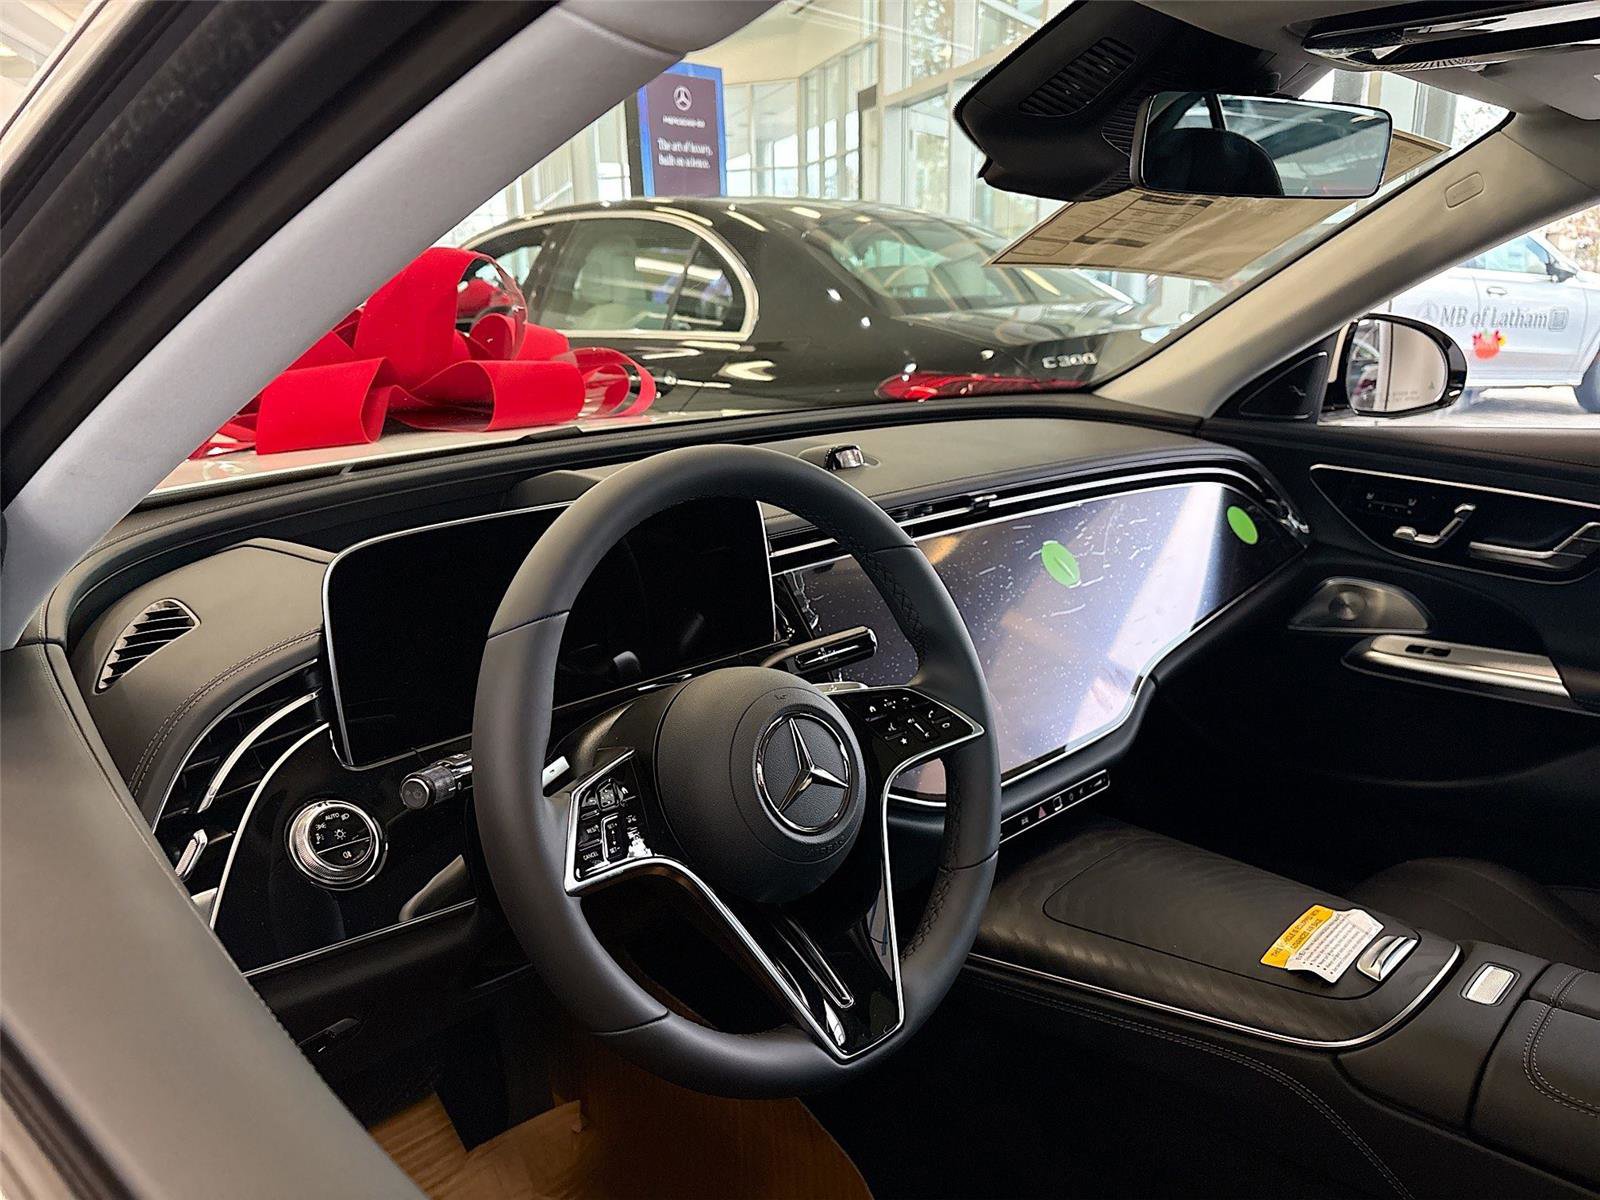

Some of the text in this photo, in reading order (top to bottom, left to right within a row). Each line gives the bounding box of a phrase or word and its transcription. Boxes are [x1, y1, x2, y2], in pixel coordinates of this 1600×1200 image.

[1440, 304, 1468, 328] MB
[1470, 305, 1490, 330] of
[1491, 306, 1548, 329] Latham
[325, 812, 340, 820] AUTO
[583, 851, 599, 861] CANCEL
